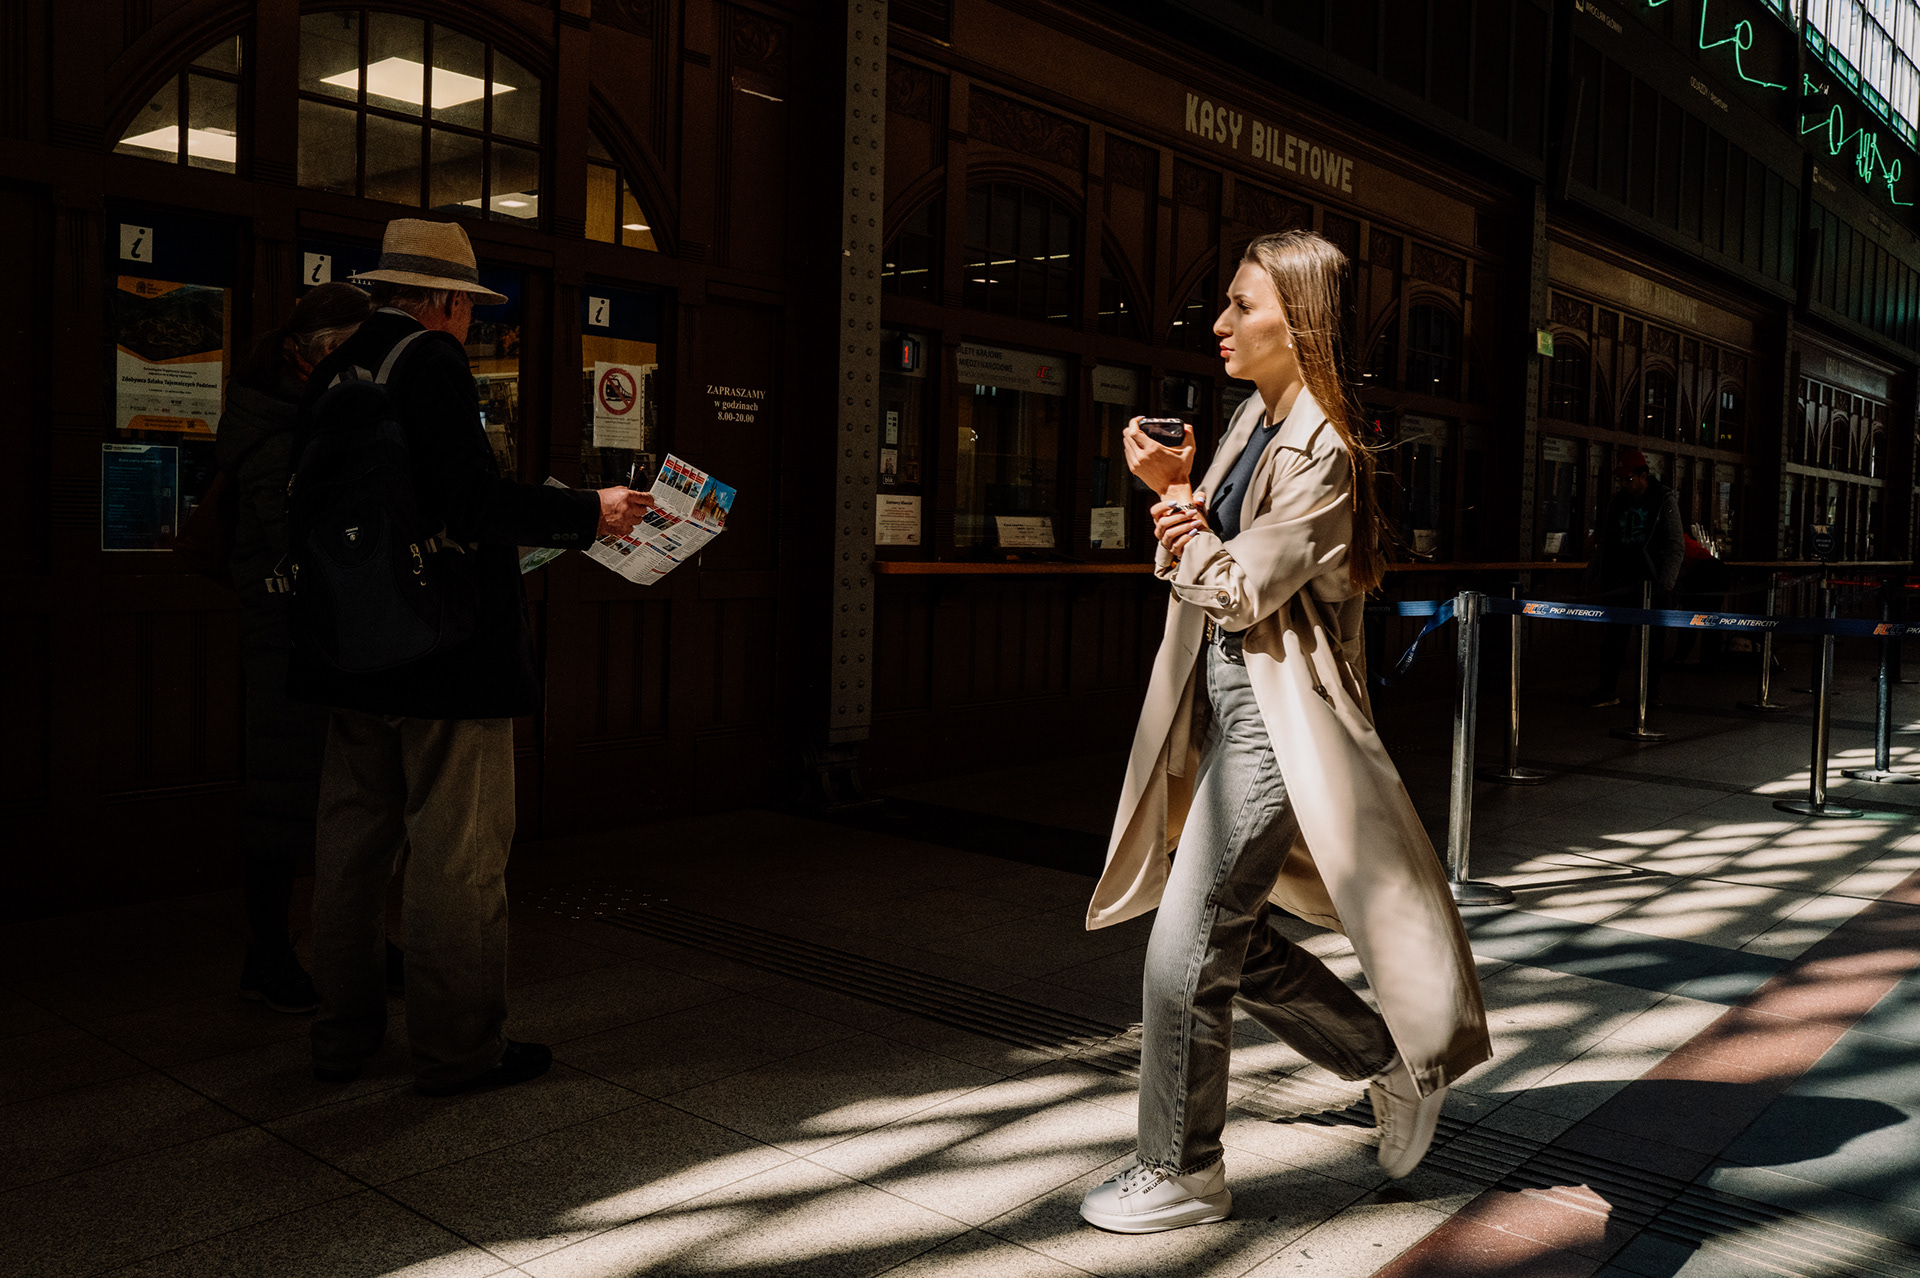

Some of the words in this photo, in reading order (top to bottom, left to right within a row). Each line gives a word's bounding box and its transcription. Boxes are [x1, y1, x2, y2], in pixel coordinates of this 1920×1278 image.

[1185, 92, 1243, 150] KASY
[1251, 120, 1353, 194] BILETOWE
[975, 348, 1003, 360] KRAJOWE
[706, 384, 766, 400] ZAPRASZAMY
[721, 400, 759, 412] godzinach
[717, 411, 755, 424] 8.00-20.00
[1566, 608, 1605, 617] INTERCITY
[1718, 617, 1737, 625] PKP
[1737, 618, 1779, 627] INTERCITY
